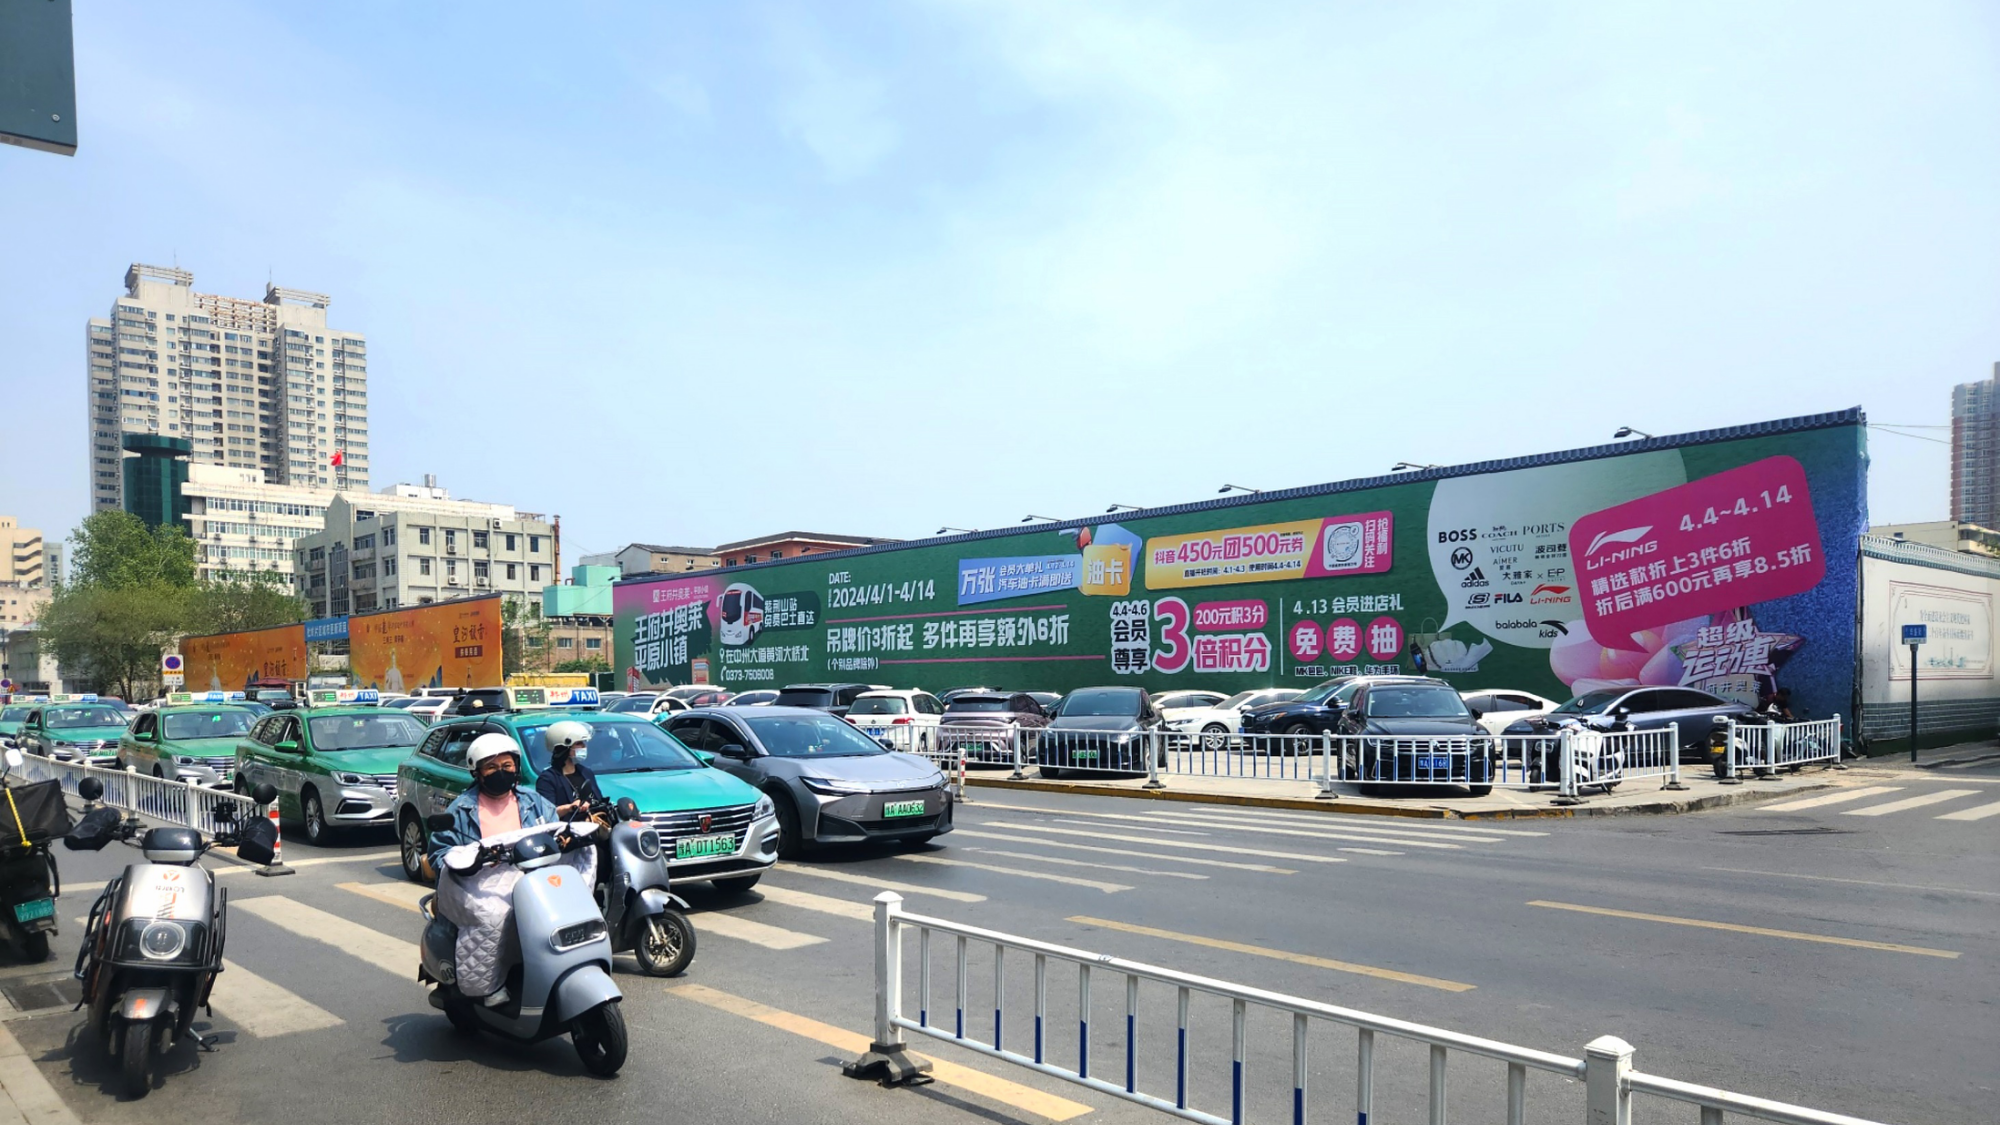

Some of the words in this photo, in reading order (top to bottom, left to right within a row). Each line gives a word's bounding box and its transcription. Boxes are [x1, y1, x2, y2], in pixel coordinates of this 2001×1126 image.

[1679, 485, 1792, 532] 4.4~4.14
[1438, 528, 1477, 543] BOSS
[1481, 530, 1518, 539] COACH
[1523, 522, 1565, 535] PORTS
[1490, 544, 1524, 554] VICUTU
[1535, 543, 1567, 555] 波司登
[1586, 541, 1658, 571] LI-NING
[999, 561, 1043, 577] 会员大单礼
[1087, 559, 1123, 585] 油卡
[1223, 565, 1245, 574] 4.1-4.3
[1502, 570, 1533, 581] 大雅家
[1590, 536, 1751, 597] 精选款折上3件6折
[828, 571, 851, 584] DATE:
[960, 567, 996, 596] 万张
[998, 573, 1072, 592] 汽车油卡满即送
[1461, 579, 1489, 589] adidas
[1595, 543, 1812, 617] 折后满600元再享8.5折
[832, 579, 935, 608] 2024/4/1-4/14
[1494, 593, 1523, 605] FILA
[1530, 596, 1572, 605] LI-NING
[1113, 603, 1147, 617] 4.4-4.6
[1293, 599, 1327, 614] 4.13
[1332, 593, 1404, 613] 会员进店礼
[634, 600, 703, 644] 王府井奥莱
[764, 610, 815, 628] 免费巴士直达
[1196, 605, 1264, 625] 200元积3分
[1495, 619, 1538, 630] balabala
[827, 623, 914, 653] 吊牌价3折起
[922, 614, 1070, 650] 多件再享额外6折
[1113, 619, 1147, 643] 会员
[1295, 627, 1318, 655] 免
[1333, 625, 1356, 654] 费
[1371, 623, 1397, 654] 抽
[1538, 629, 1558, 638] kids
[1698, 618, 1756, 648] 超级
[634, 635, 688, 672] 平原小镇
[725, 645, 809, 664] 在中州大道黄河大桥北
[1113, 648, 1148, 671] 尊享
[359, 691, 378, 700] TAXI
[573, 690, 597, 702] TAXI
